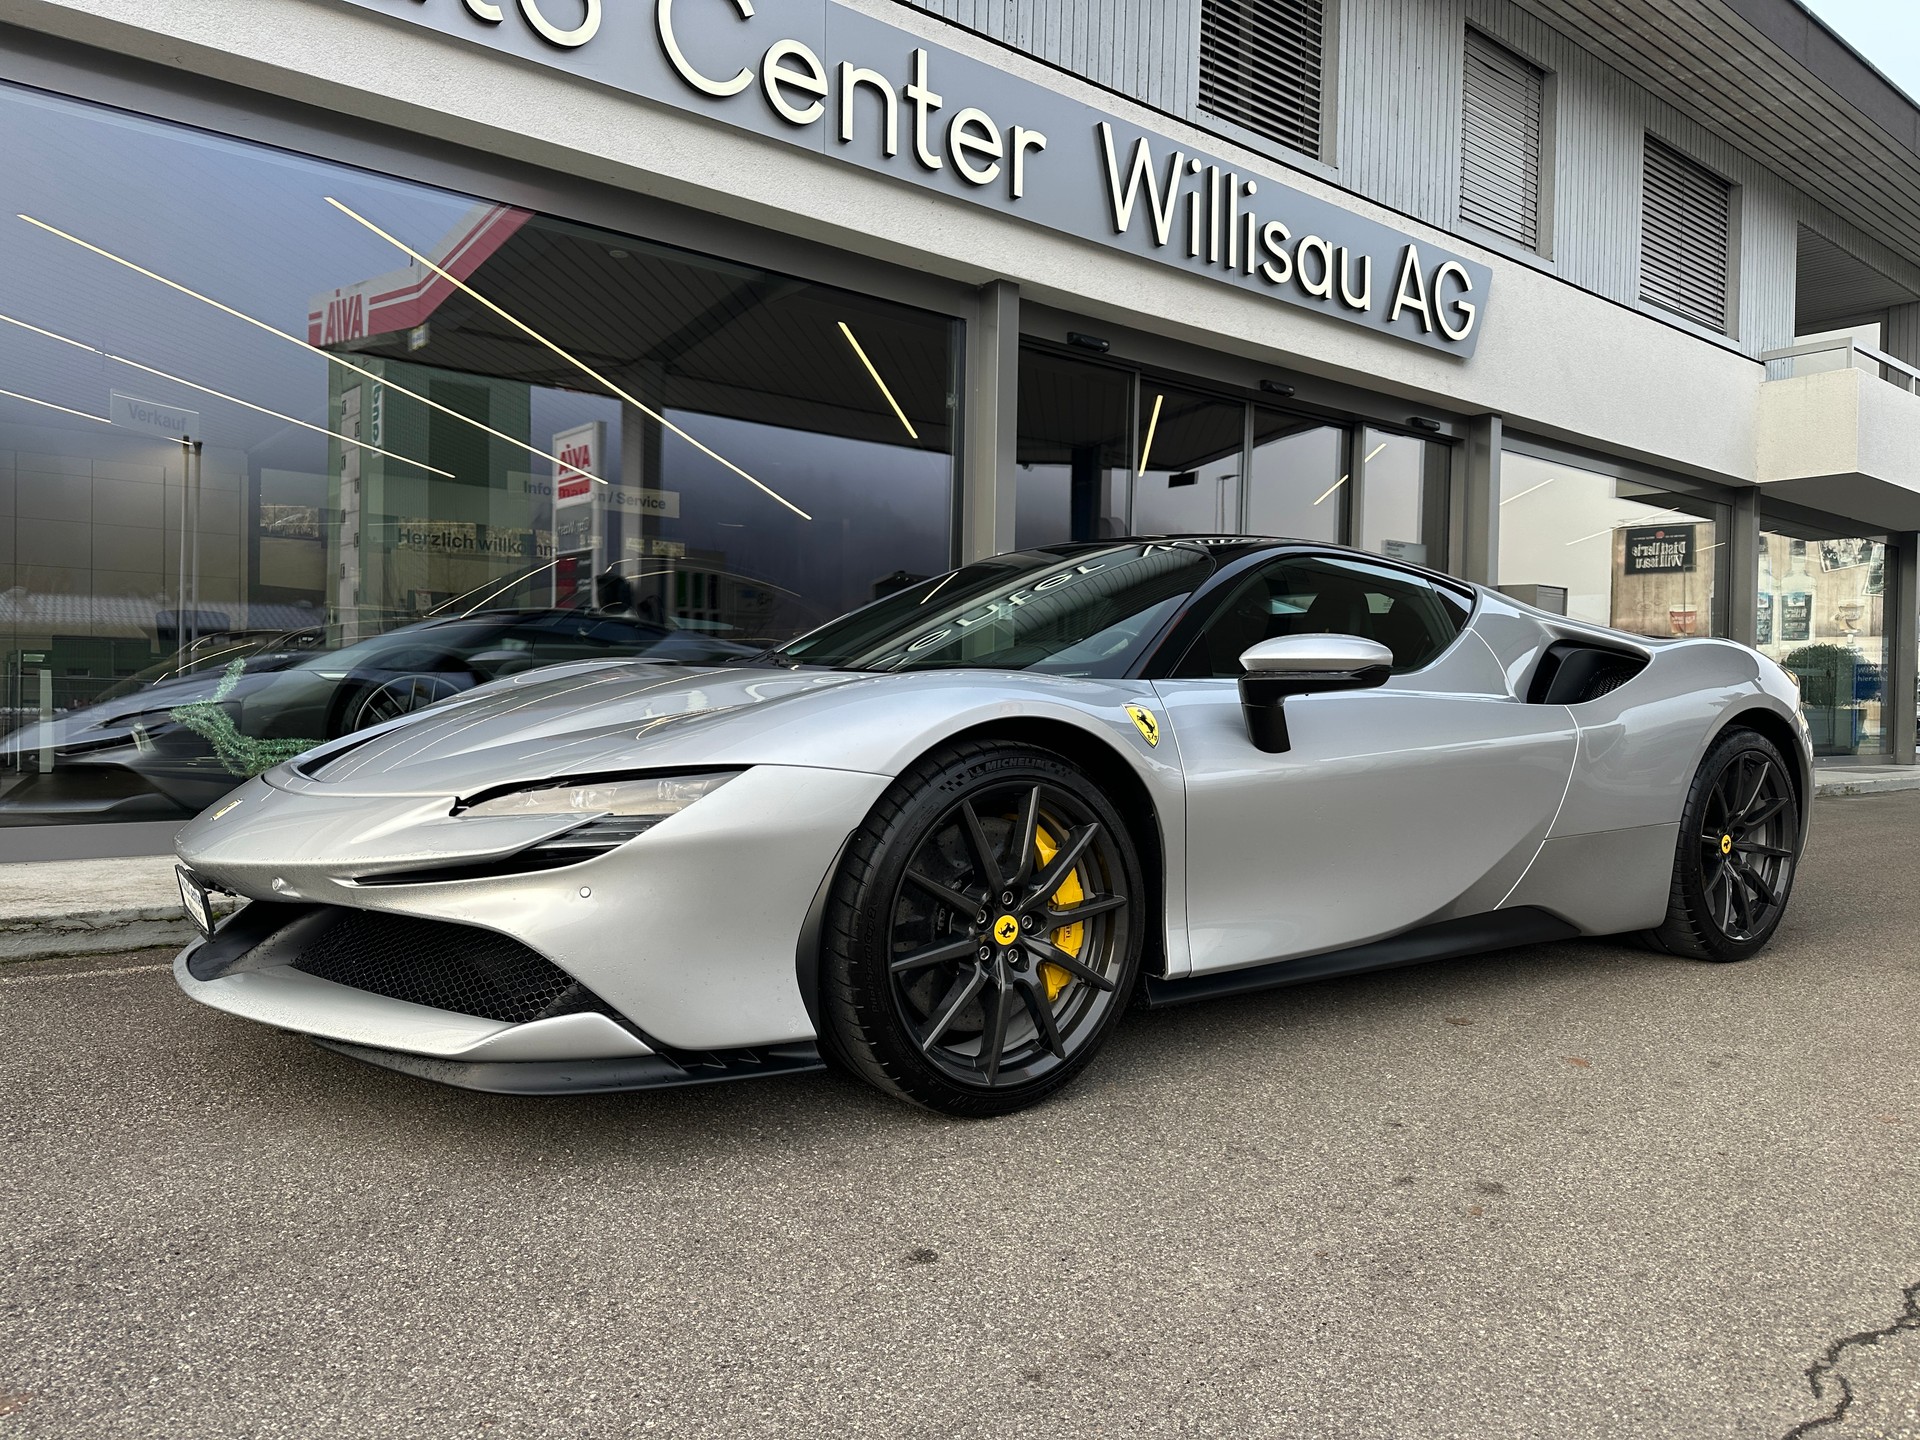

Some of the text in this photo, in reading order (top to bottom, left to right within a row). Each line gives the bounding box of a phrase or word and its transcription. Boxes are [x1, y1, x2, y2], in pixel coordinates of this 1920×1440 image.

[655, 0, 1476, 342] Center Willisau AG
[127, 402, 187, 432] Verkauf
[616, 493, 667, 510] Service
[398, 527, 474, 549] Herzlich
[986, 757, 1048, 772] MICHELIN
[865, 920, 876, 944] Cup
[864, 945, 875, 982] Sport
